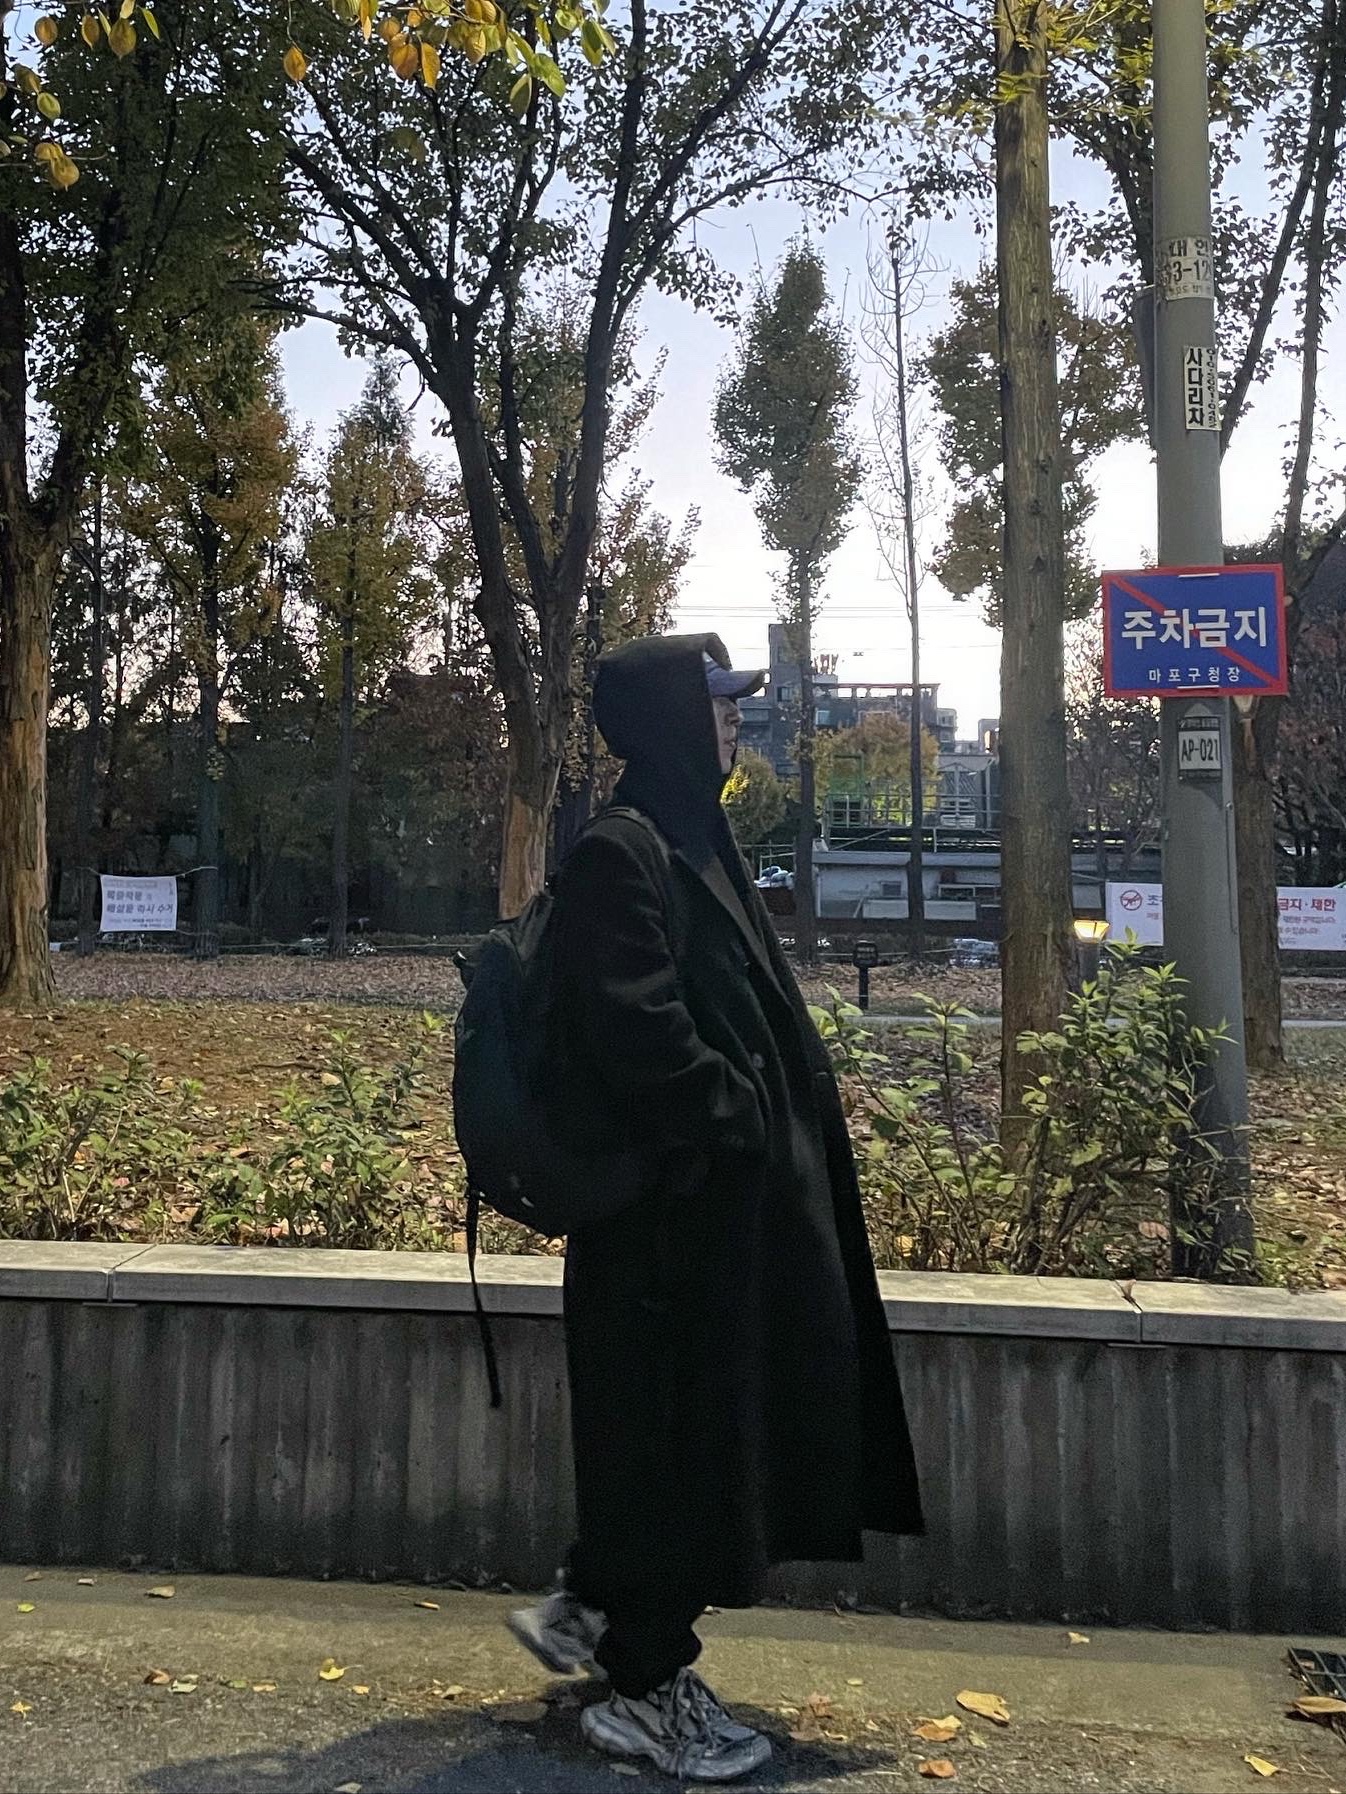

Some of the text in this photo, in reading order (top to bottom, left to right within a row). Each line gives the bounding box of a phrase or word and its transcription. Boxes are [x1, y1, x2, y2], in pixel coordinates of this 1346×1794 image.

[1187, 347, 1205, 427] 사다리차
[1121, 606, 1267, 650] 주차금지
[1181, 738, 1219, 762] AP-021
